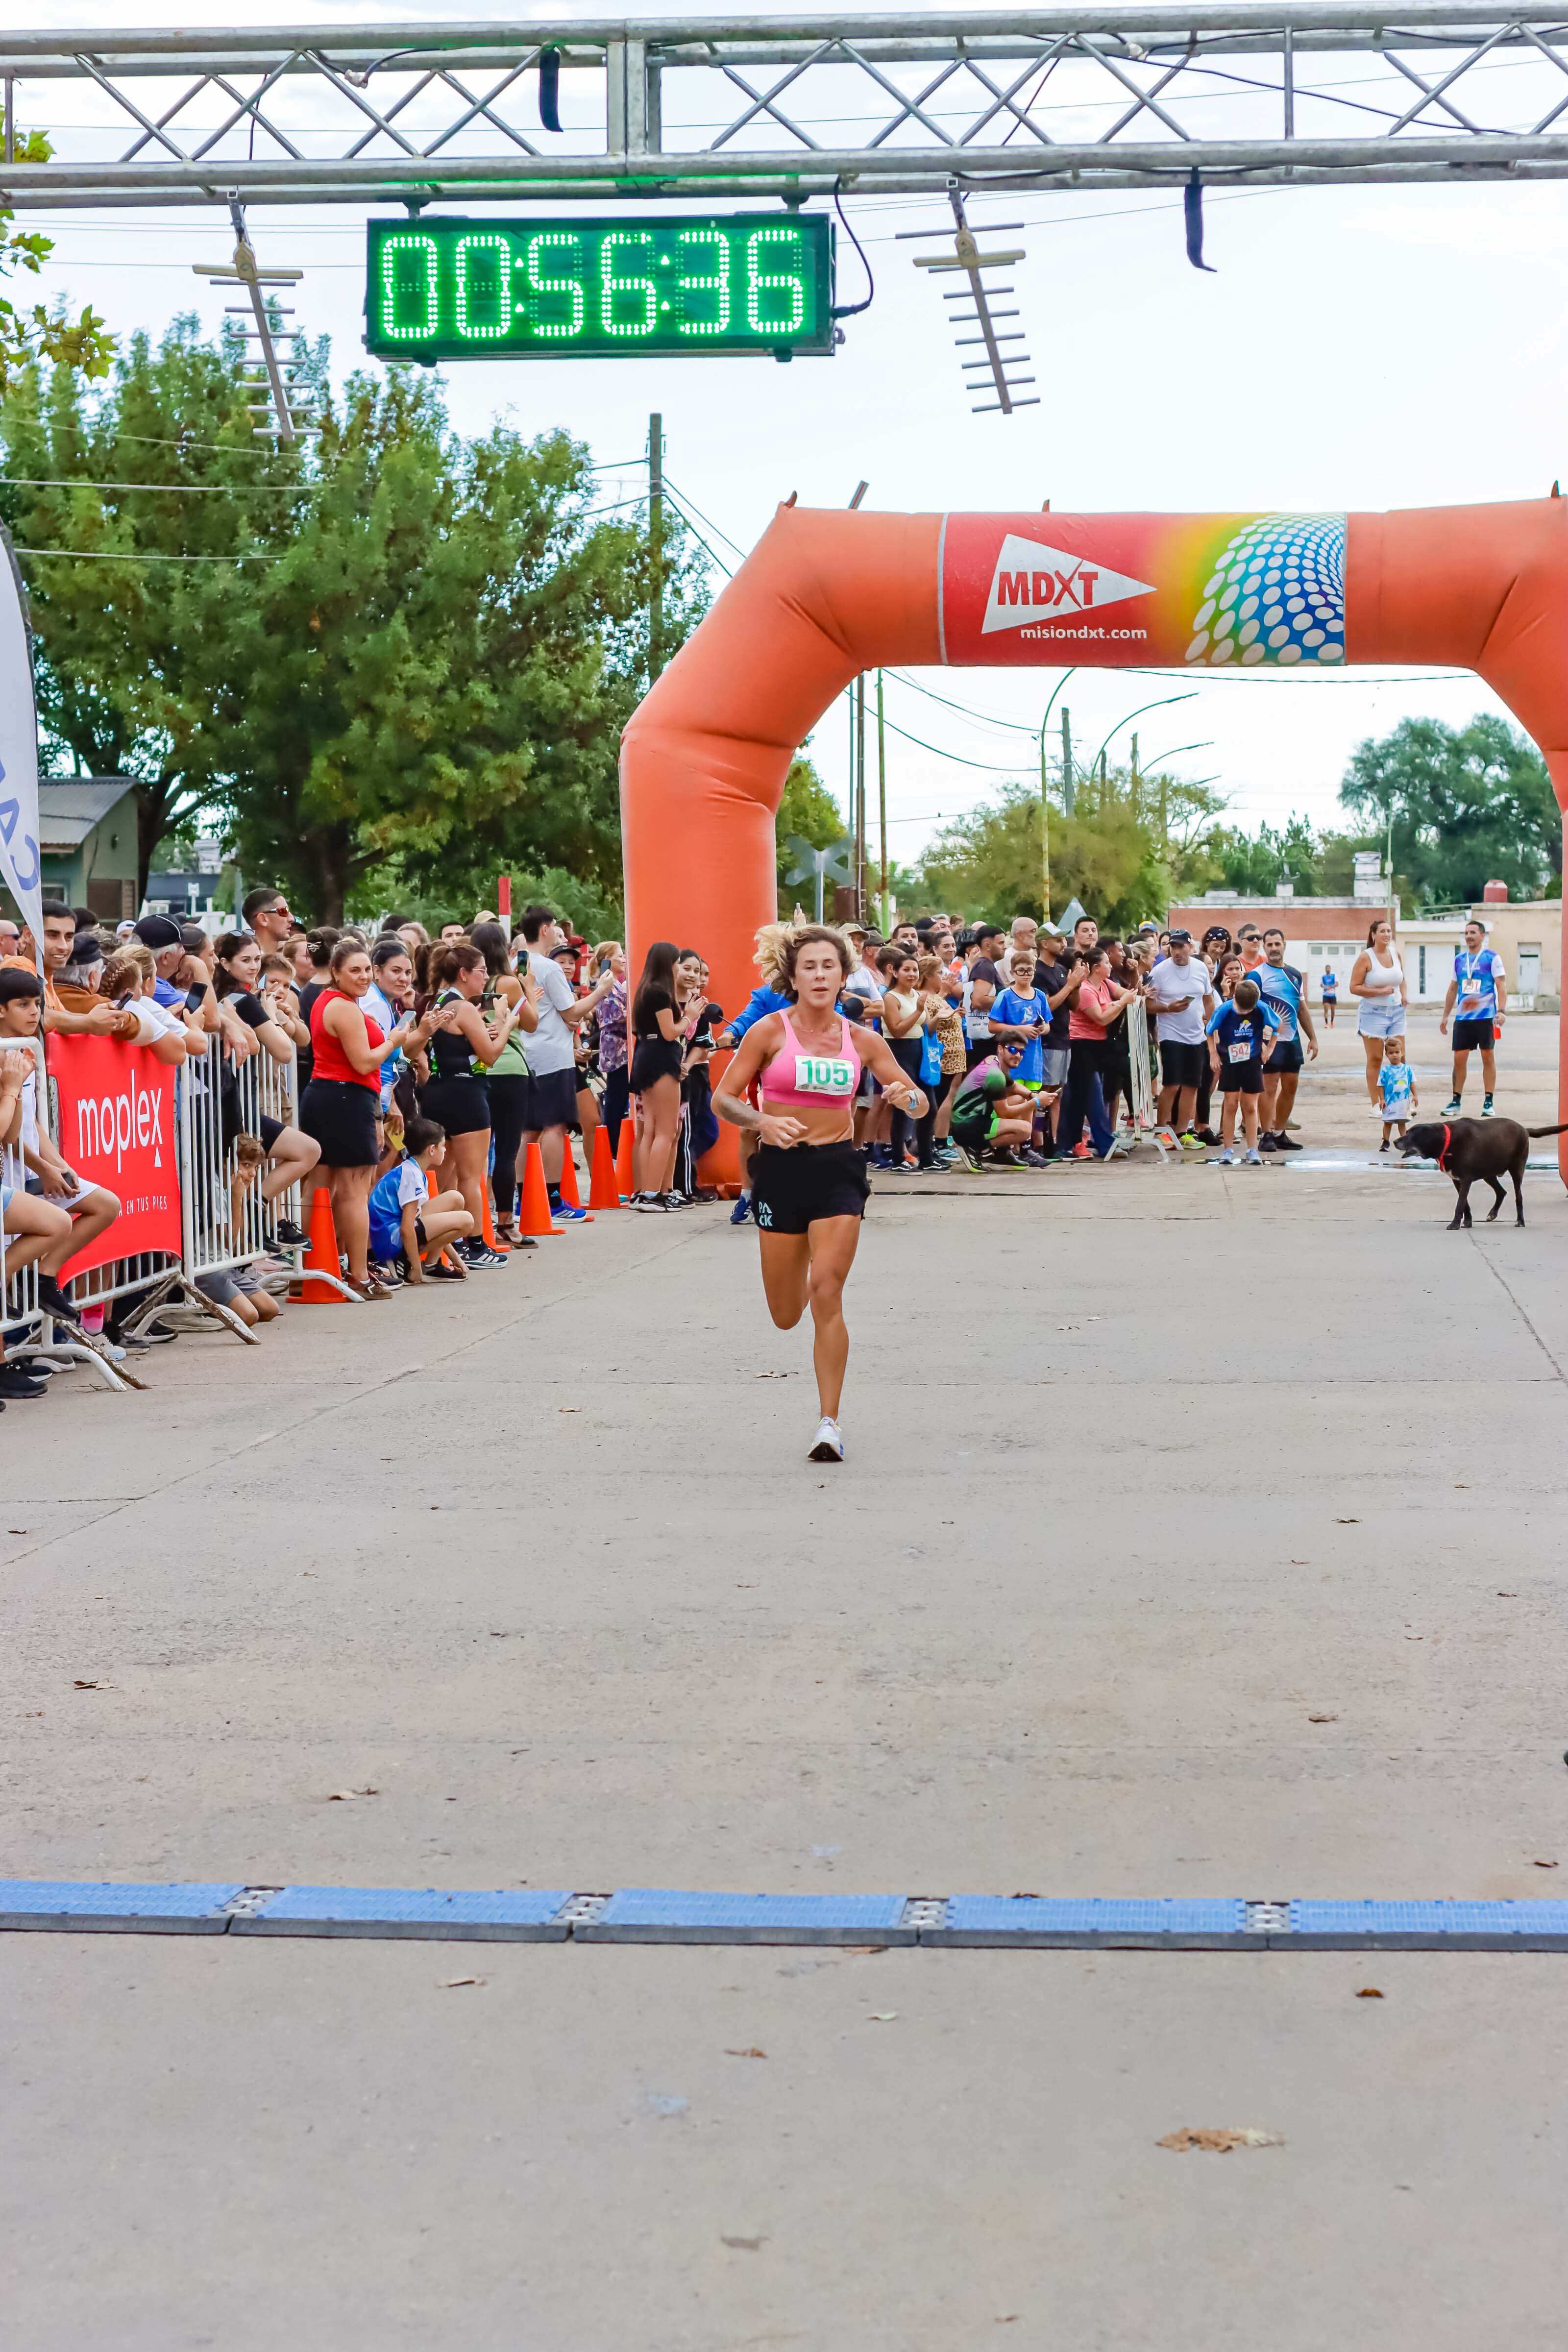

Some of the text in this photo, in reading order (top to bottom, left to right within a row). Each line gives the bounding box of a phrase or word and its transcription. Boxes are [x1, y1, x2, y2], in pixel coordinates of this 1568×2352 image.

[382, 229, 804, 338] 00:56:36
[997, 560, 1099, 610] MDXT
[1020, 626, 1148, 639] misiondxt.com
[1231, 1043, 1250, 1057] 542
[802, 1060, 848, 1085] 105
[77, 1069, 163, 1174] moplex
[126, 1200, 134, 1215] EN
[137, 1196, 149, 1212] TUS
[153, 1196, 168, 1210] PIES
